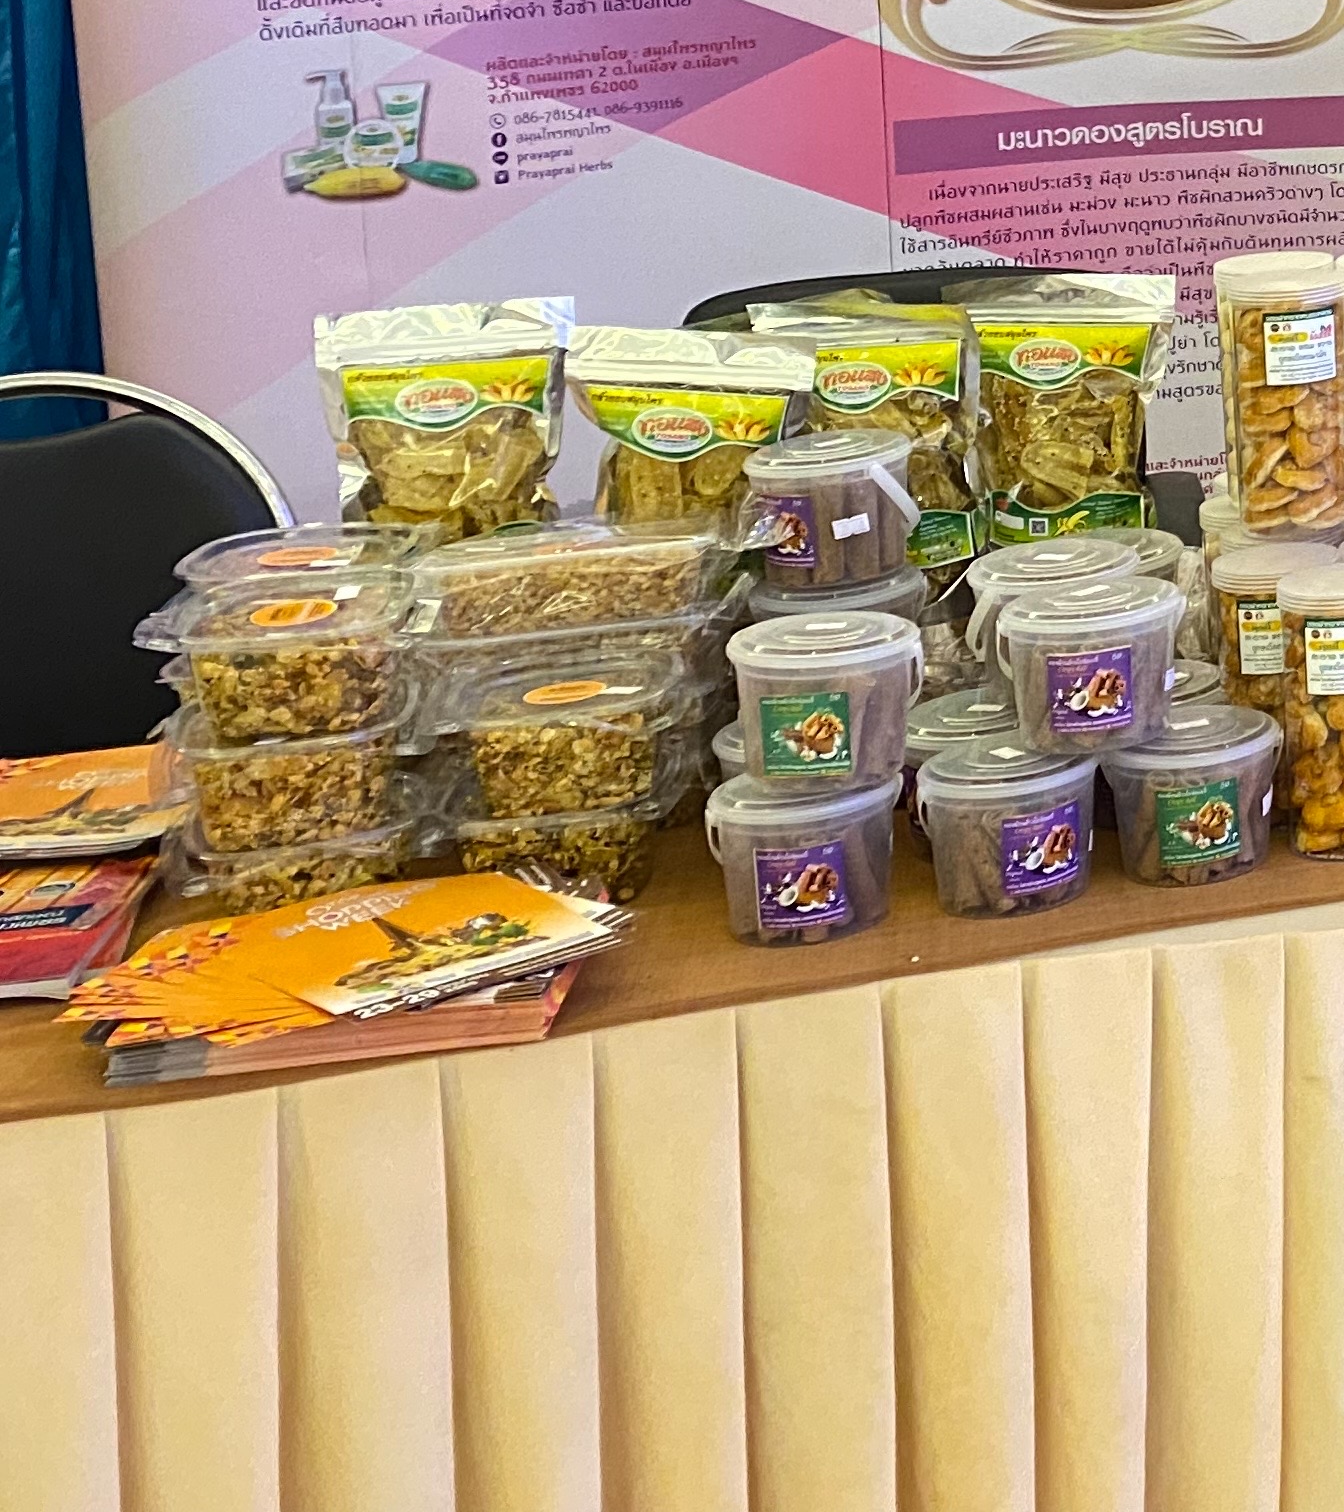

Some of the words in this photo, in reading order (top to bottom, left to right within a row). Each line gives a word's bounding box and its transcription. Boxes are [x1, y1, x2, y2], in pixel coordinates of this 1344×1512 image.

[590, 78, 640, 95] 62000
[997, 112, 1264, 151] มะนาวดองสูตรโบราณ
[579, 159, 614, 173] Herbs
[1123, 193, 1171, 209] มะนาว
